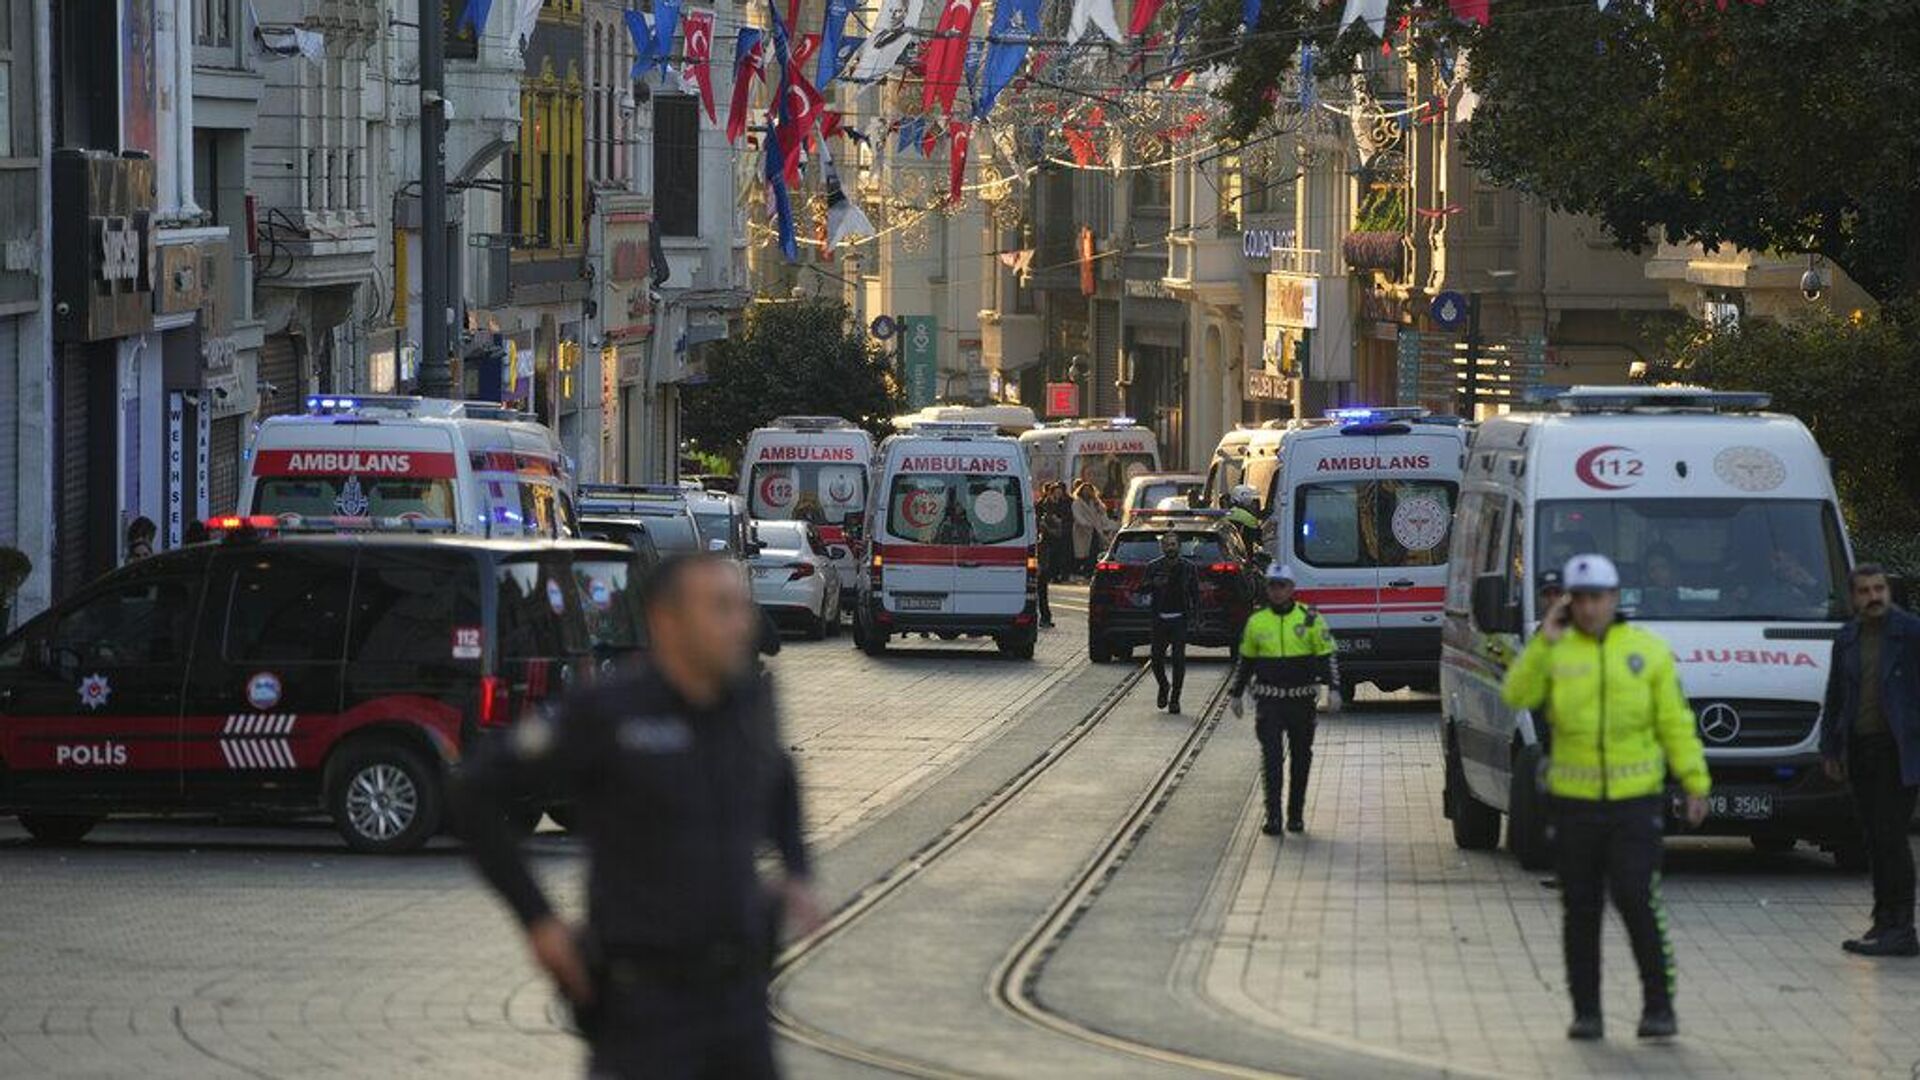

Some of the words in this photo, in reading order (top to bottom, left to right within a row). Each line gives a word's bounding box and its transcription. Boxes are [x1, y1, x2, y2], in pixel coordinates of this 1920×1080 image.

[759, 446, 855, 461] AMBULANS
[1079, 441, 1144, 452] AMBULANS
[288, 453, 411, 473] AMBULANS
[901, 457, 1009, 472] AMBULANS
[1316, 455, 1430, 472] AMBULANS
[1594, 459, 1644, 477] 112
[171, 411, 181, 543] WECHSEL
[769, 484, 793, 498] 112
[914, 501, 937, 515] 112
[456, 629, 480, 646] 112
[56, 739, 128, 766] POLİS
[1734, 795, 1770, 814] 3504
